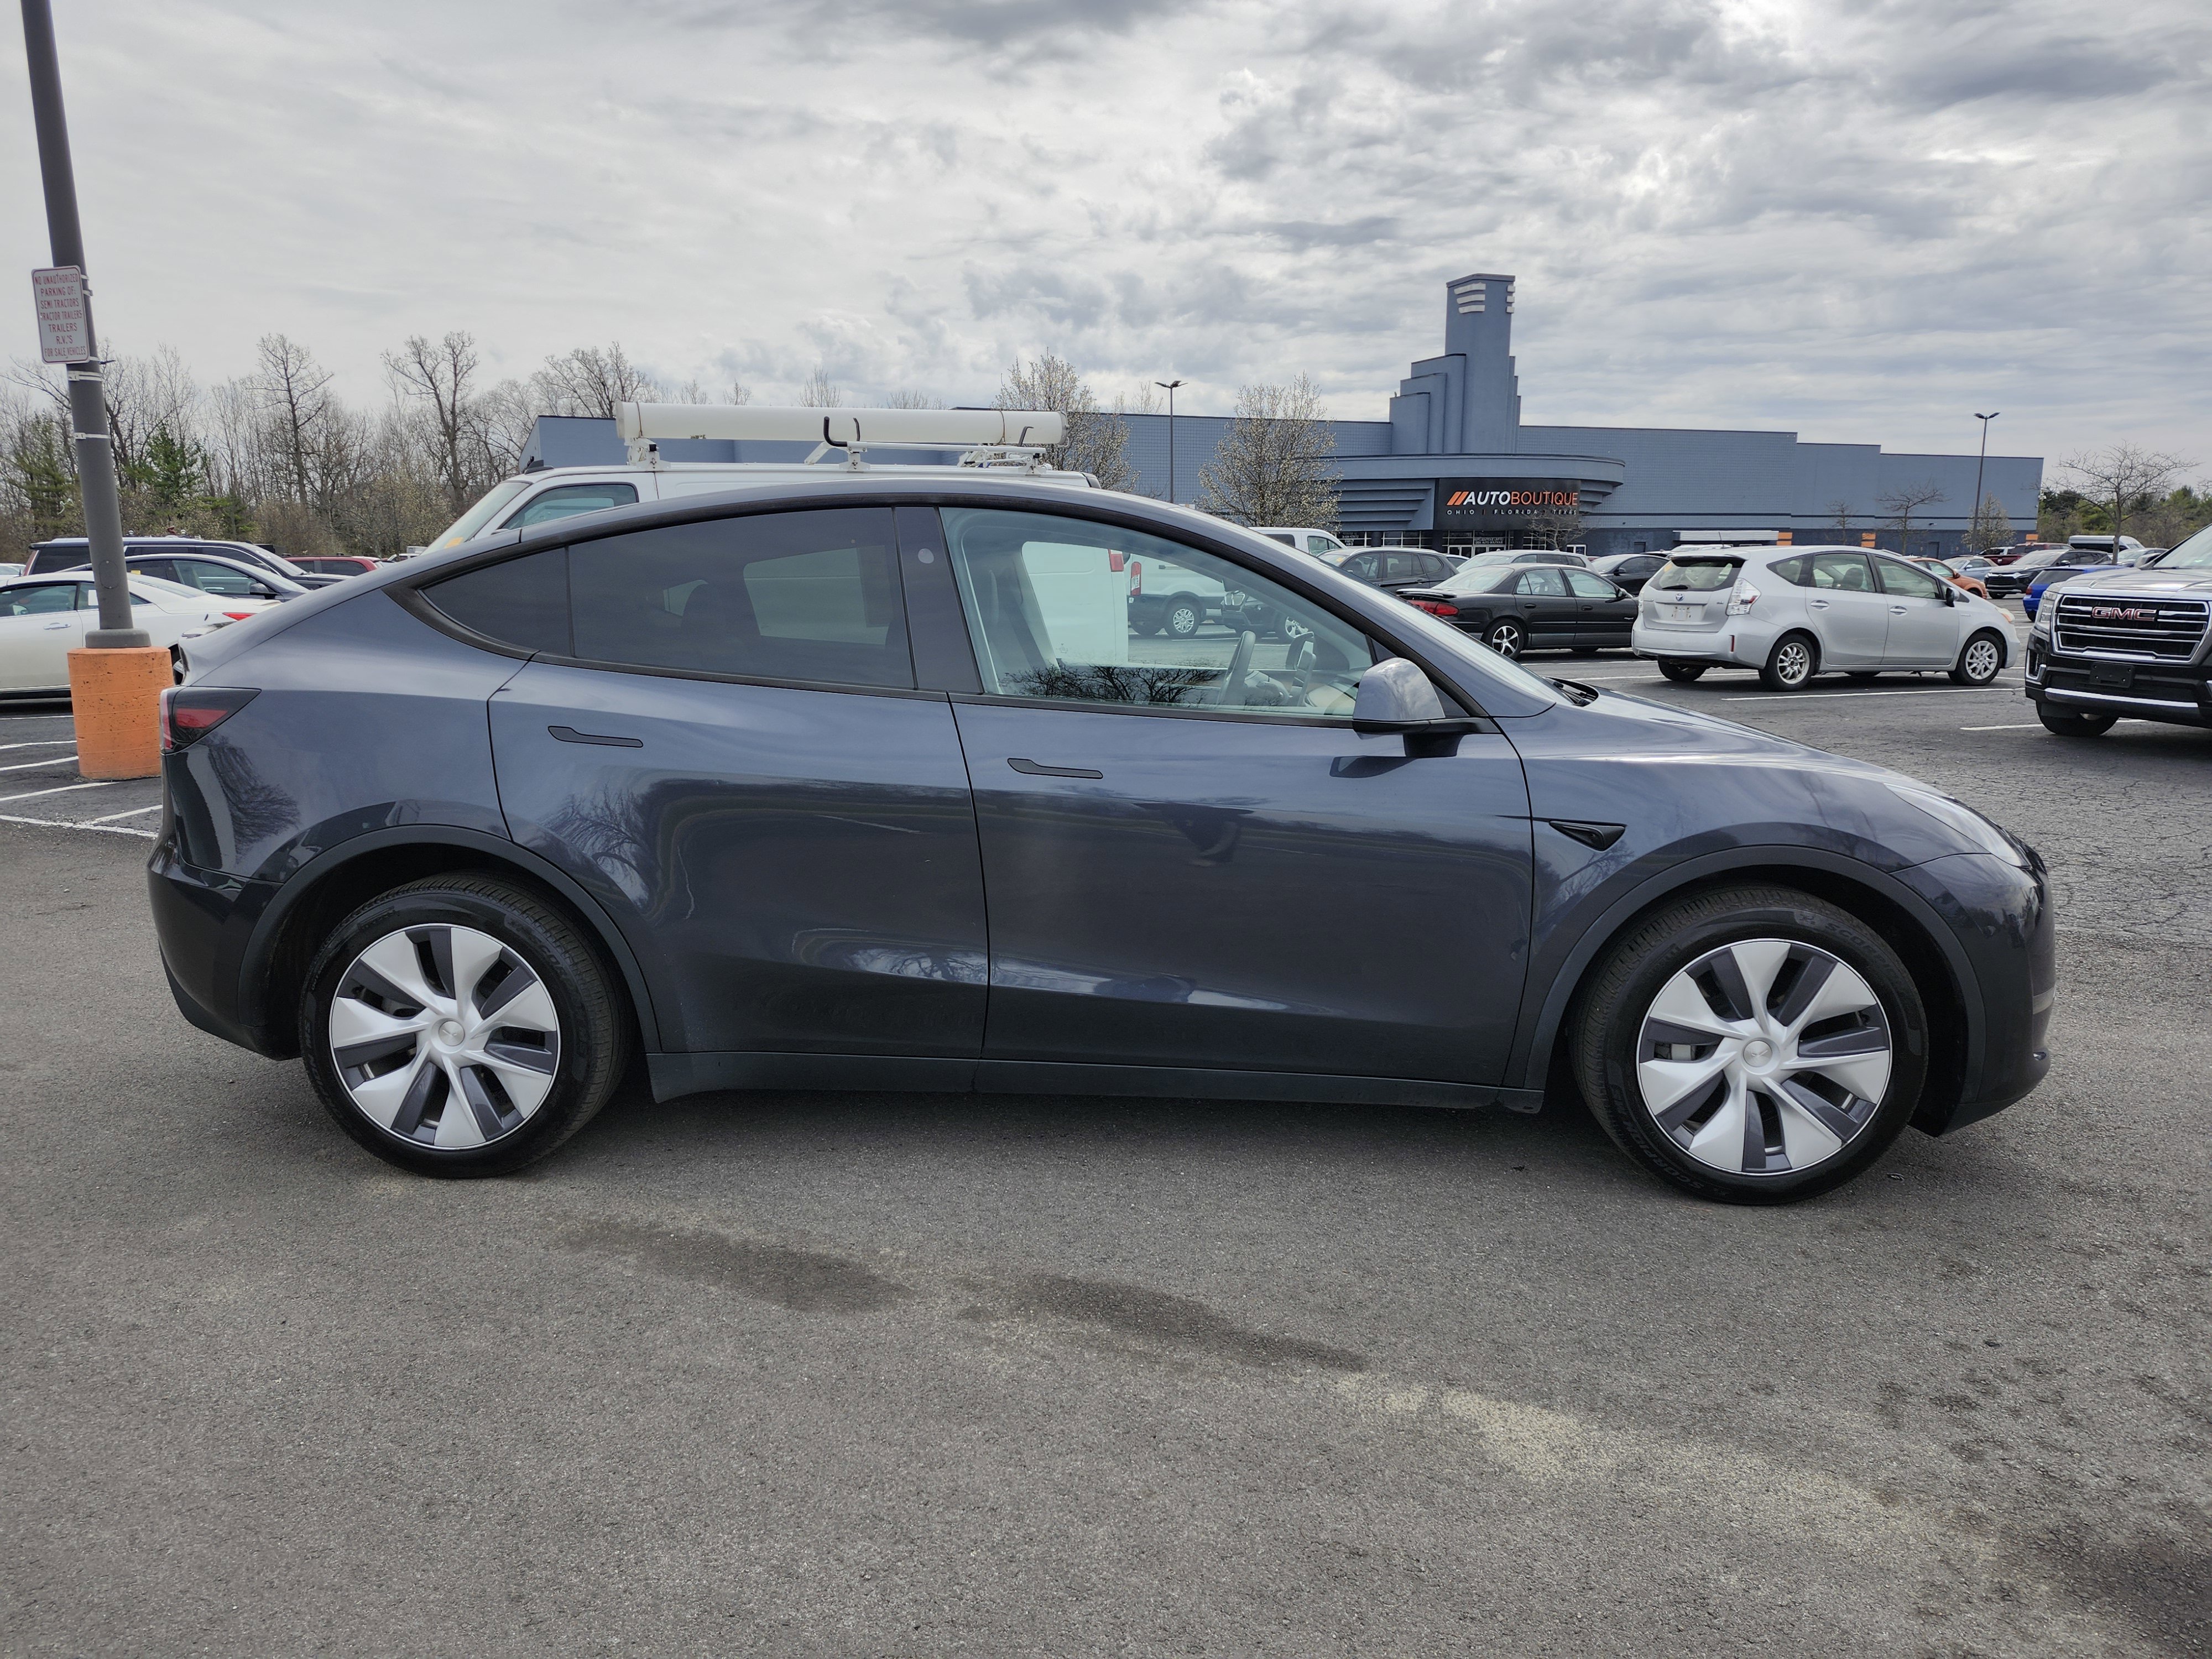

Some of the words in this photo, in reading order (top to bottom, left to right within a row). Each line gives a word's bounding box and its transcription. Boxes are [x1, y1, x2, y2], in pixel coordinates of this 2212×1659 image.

[35, 276, 41, 285] NO
[44, 274, 79, 284] UNAUTHORIZED
[41, 287, 66, 296] PARKING
[67, 286, 76, 295] OF:
[40, 300, 53, 309] SEMI
[54, 298, 79, 308] TRACTORS
[40, 311, 61, 321] TRACTOR
[62, 310, 82, 320] TRAILERS
[49, 323, 77, 333] TRAILERS
[44, 348, 53, 357] FOR
[54, 347, 65, 356] SALE
[67, 346, 86, 356] VEHICLES
[2091, 606, 2157, 622] GMC
